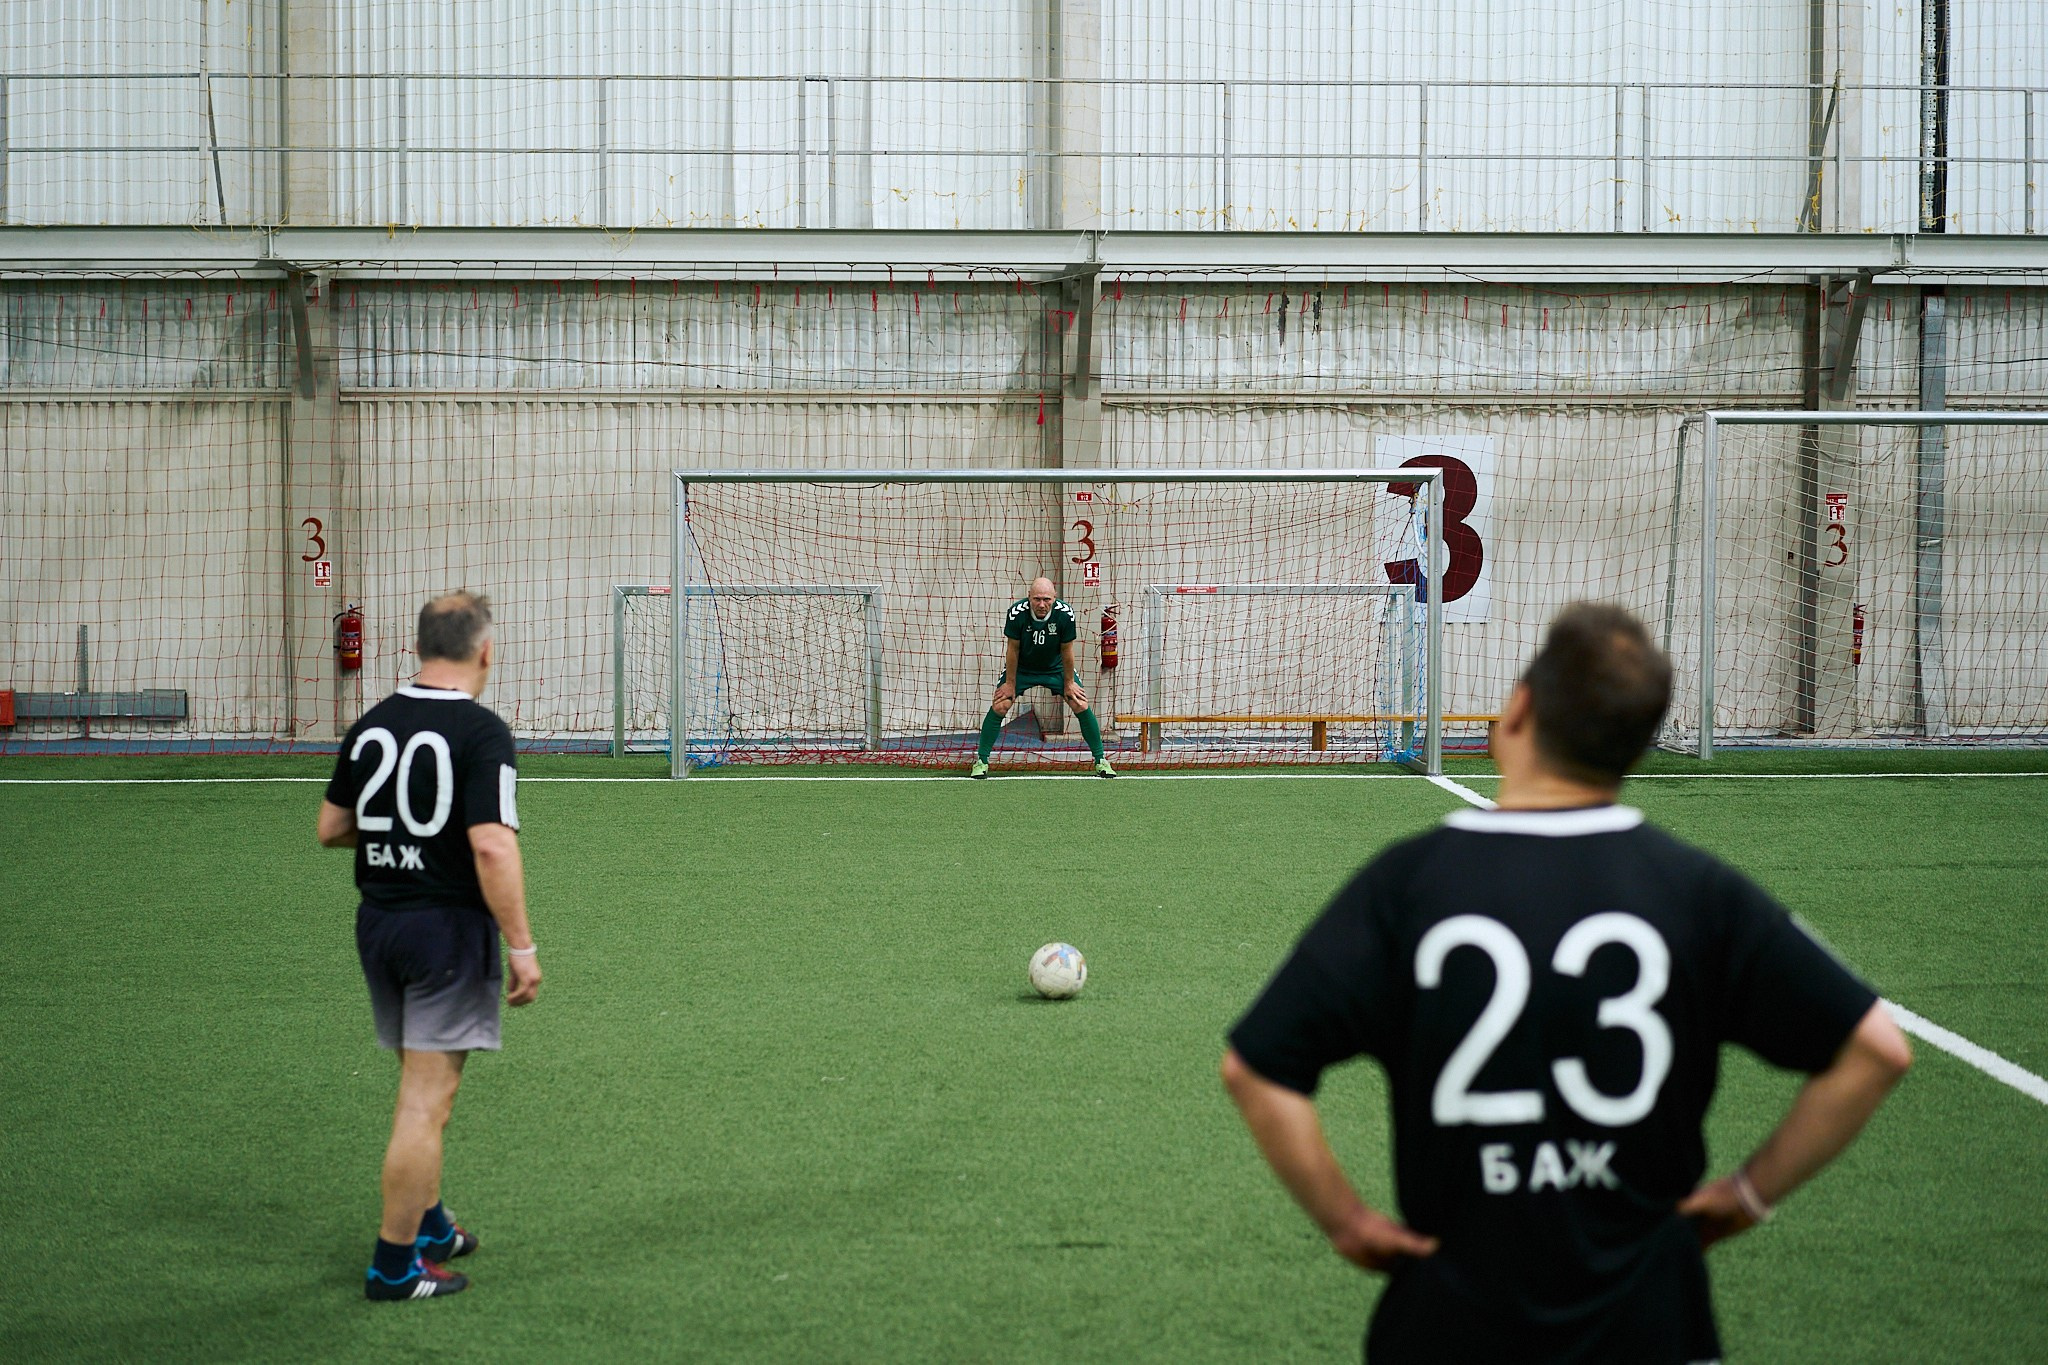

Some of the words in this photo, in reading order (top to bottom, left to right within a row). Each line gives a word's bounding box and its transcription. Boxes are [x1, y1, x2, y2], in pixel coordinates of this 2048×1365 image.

[301, 517, 326, 562] 3
[1071, 520, 1095, 564] 3
[1384, 455, 1483, 603] 3
[1824, 523, 1848, 567] 3
[350, 727, 454, 838] 20
[366, 843, 426, 871] БАЖ
[1413, 911, 1674, 1128] 23
[1479, 1137, 1622, 1195] БАЖ
